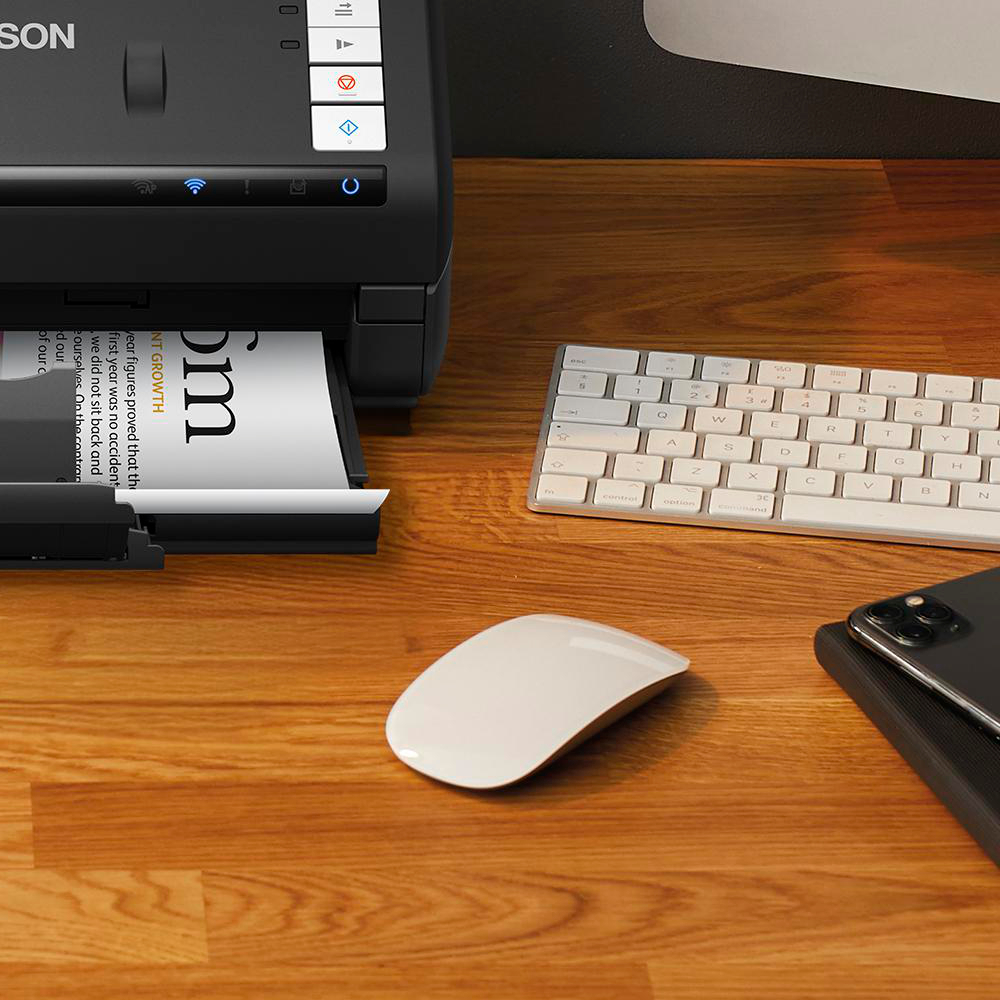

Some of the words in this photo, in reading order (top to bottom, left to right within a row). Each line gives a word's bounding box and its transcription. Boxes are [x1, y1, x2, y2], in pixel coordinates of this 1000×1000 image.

[90, 336, 100, 353] we
[108, 332, 121, 355] first
[38, 345, 47, 365] our
[56, 344, 65, 362] our
[91, 356, 103, 374] did
[105, 358, 118, 383] year
[124, 357, 139, 397] figures
[151, 353, 165, 413] GROWTH
[91, 378, 102, 398] not
[108, 386, 118, 410] was
[91, 401, 102, 415] sit
[657, 411, 668, 419] Q
[108, 413, 118, 430] no
[124, 400, 140, 442] proved
[711, 415, 727, 423] W
[90, 419, 103, 448] back
[826, 424, 836, 432] R
[666, 438, 677, 446] A
[723, 442, 734, 450] S
[127, 444, 140, 469] that
[780, 447, 791, 455] D
[90, 450, 103, 475] and
[894, 457, 905, 465] G
[863, 481, 874, 489] V
[921, 486, 931, 494] B
[663, 498, 696, 507] option
[978, 491, 990, 499] N
